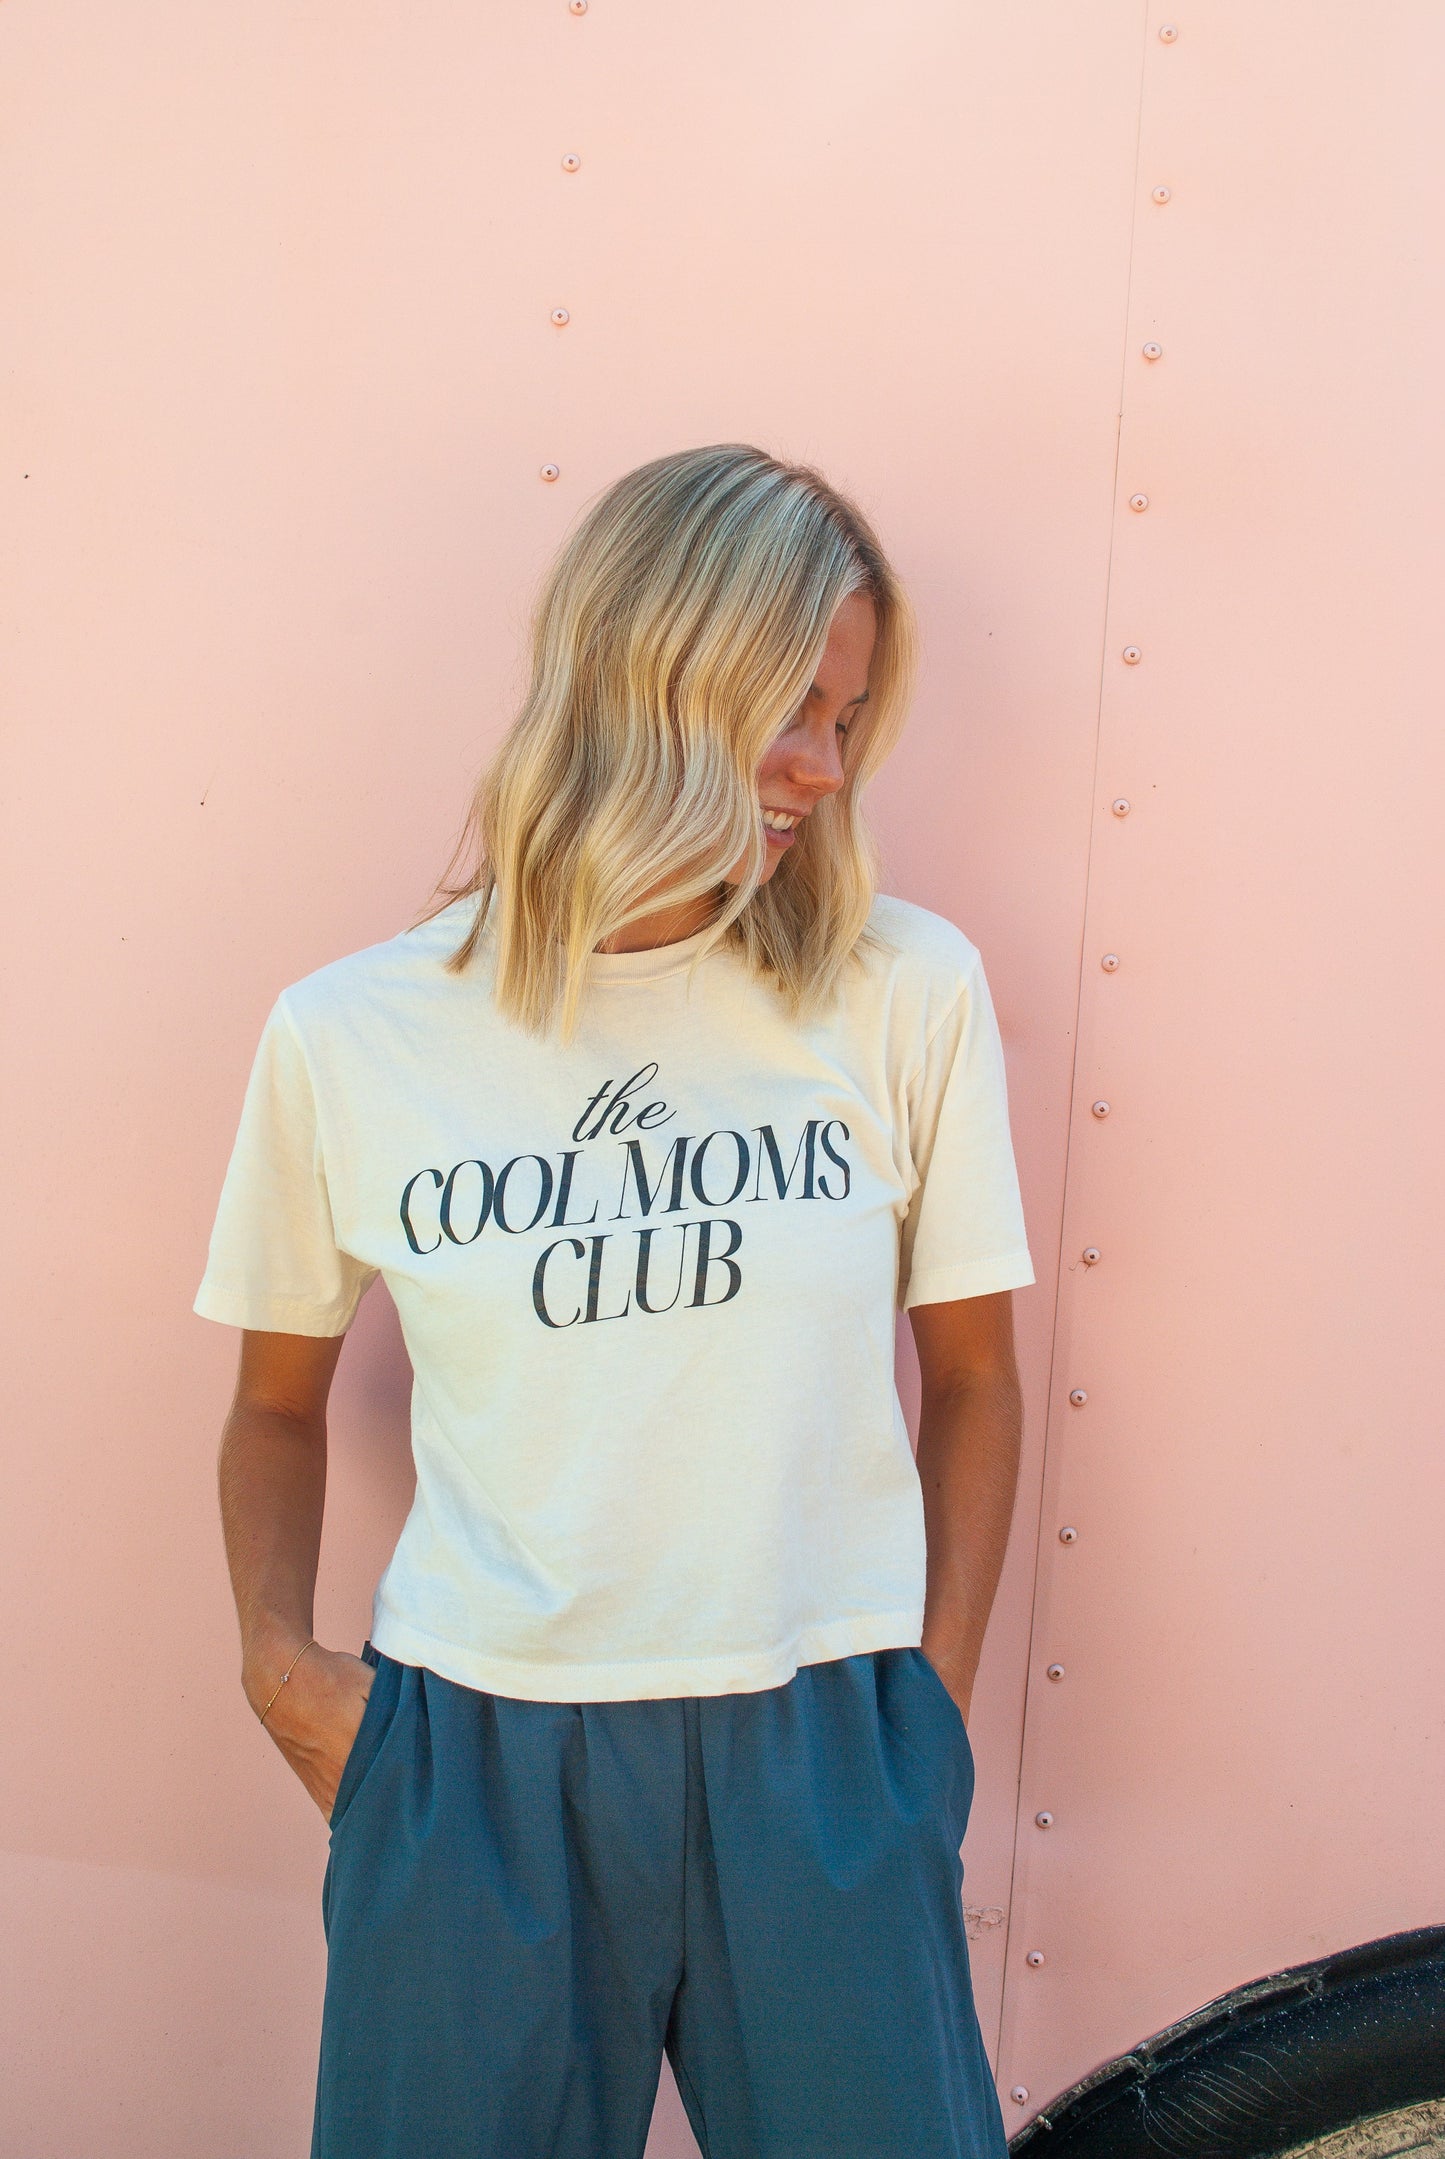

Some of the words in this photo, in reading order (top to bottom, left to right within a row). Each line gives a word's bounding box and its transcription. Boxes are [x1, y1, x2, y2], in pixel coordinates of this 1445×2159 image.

[572, 1062, 677, 1143] the
[399, 1149, 599, 1255] COOL
[608, 1120, 851, 1221] MOMS
[532, 1219, 743, 1329] CLUB
